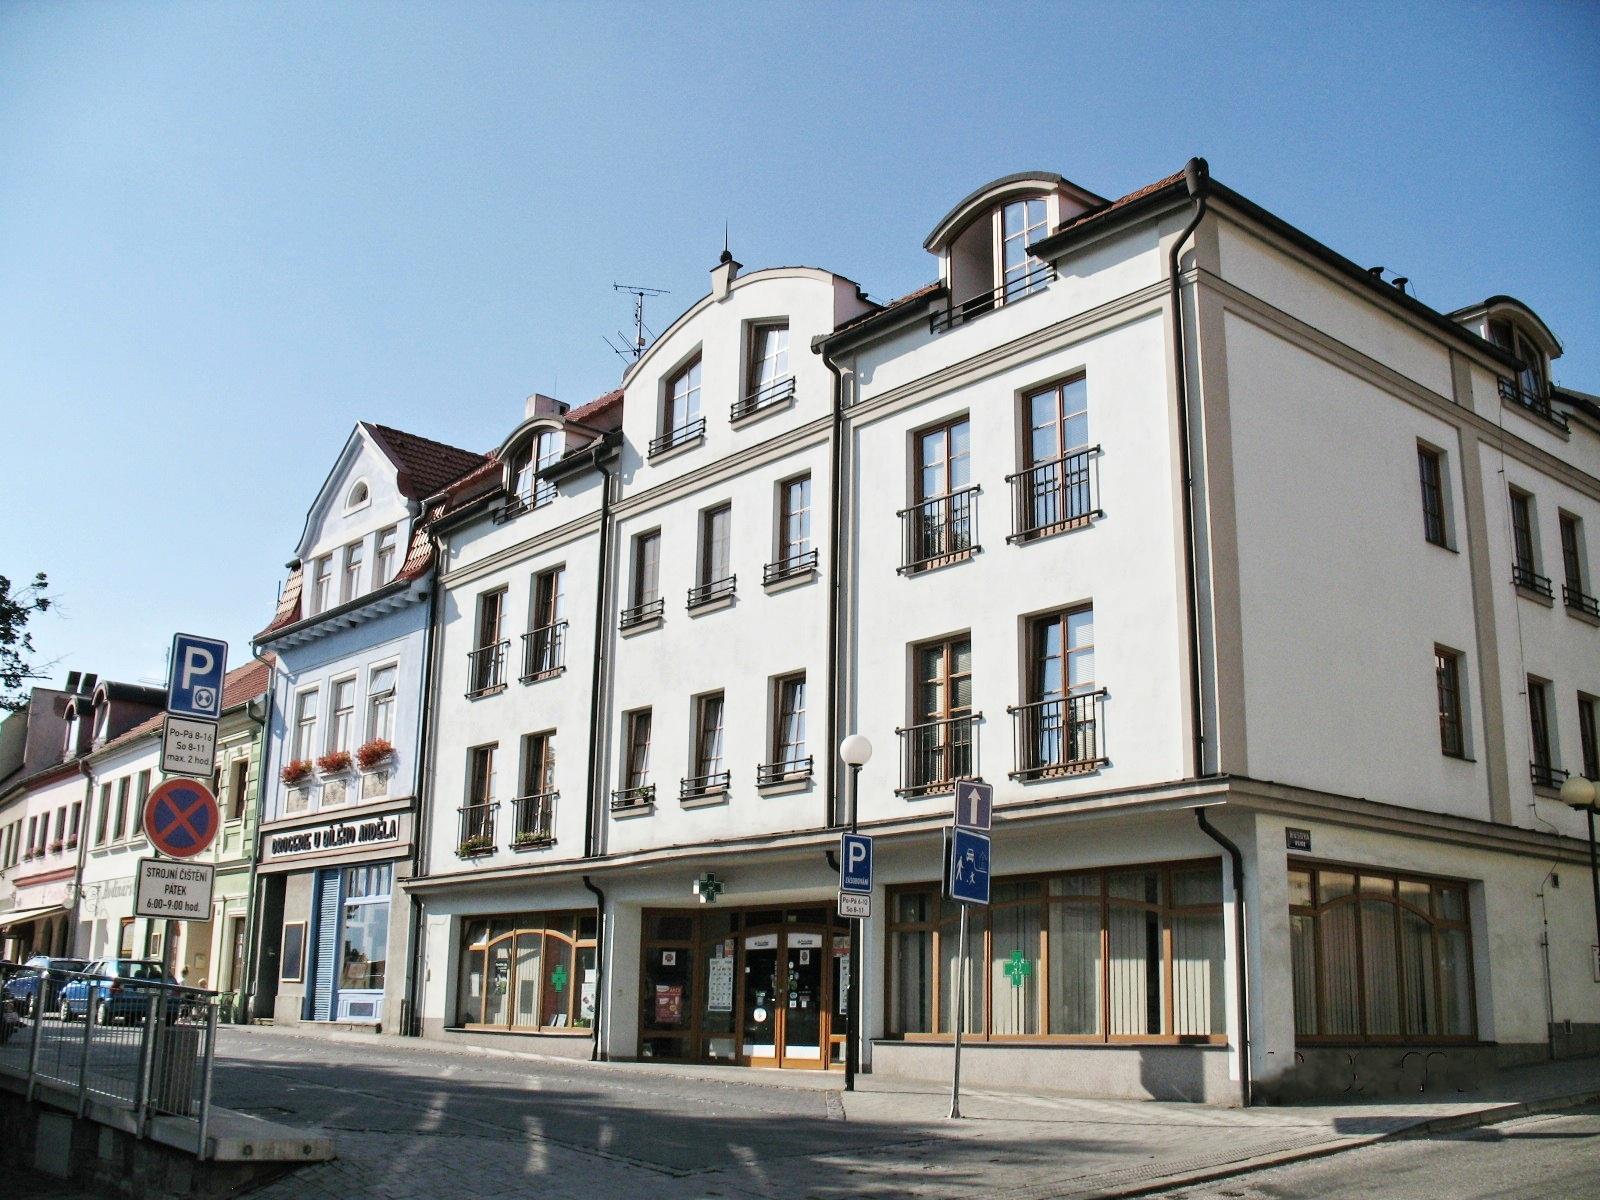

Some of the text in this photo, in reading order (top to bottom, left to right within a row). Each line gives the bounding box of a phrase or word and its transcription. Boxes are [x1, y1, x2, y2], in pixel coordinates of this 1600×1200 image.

[182, 645, 214, 689] P
[195, 731, 212, 742] 8-16
[176, 741, 205, 752] So 8-11
[167, 754, 211, 765] max. 2 hod.
[272, 832, 312, 854] DROGERIE
[313, 831, 321, 848] U
[358, 816, 397, 842] ANDĚLA
[848, 841, 866, 873] P
[146, 866, 208, 882] STROJNÍ ČIŠTĚNÍ
[164, 883, 187, 895] PÁTEK
[185, 901, 201, 912] hod.
